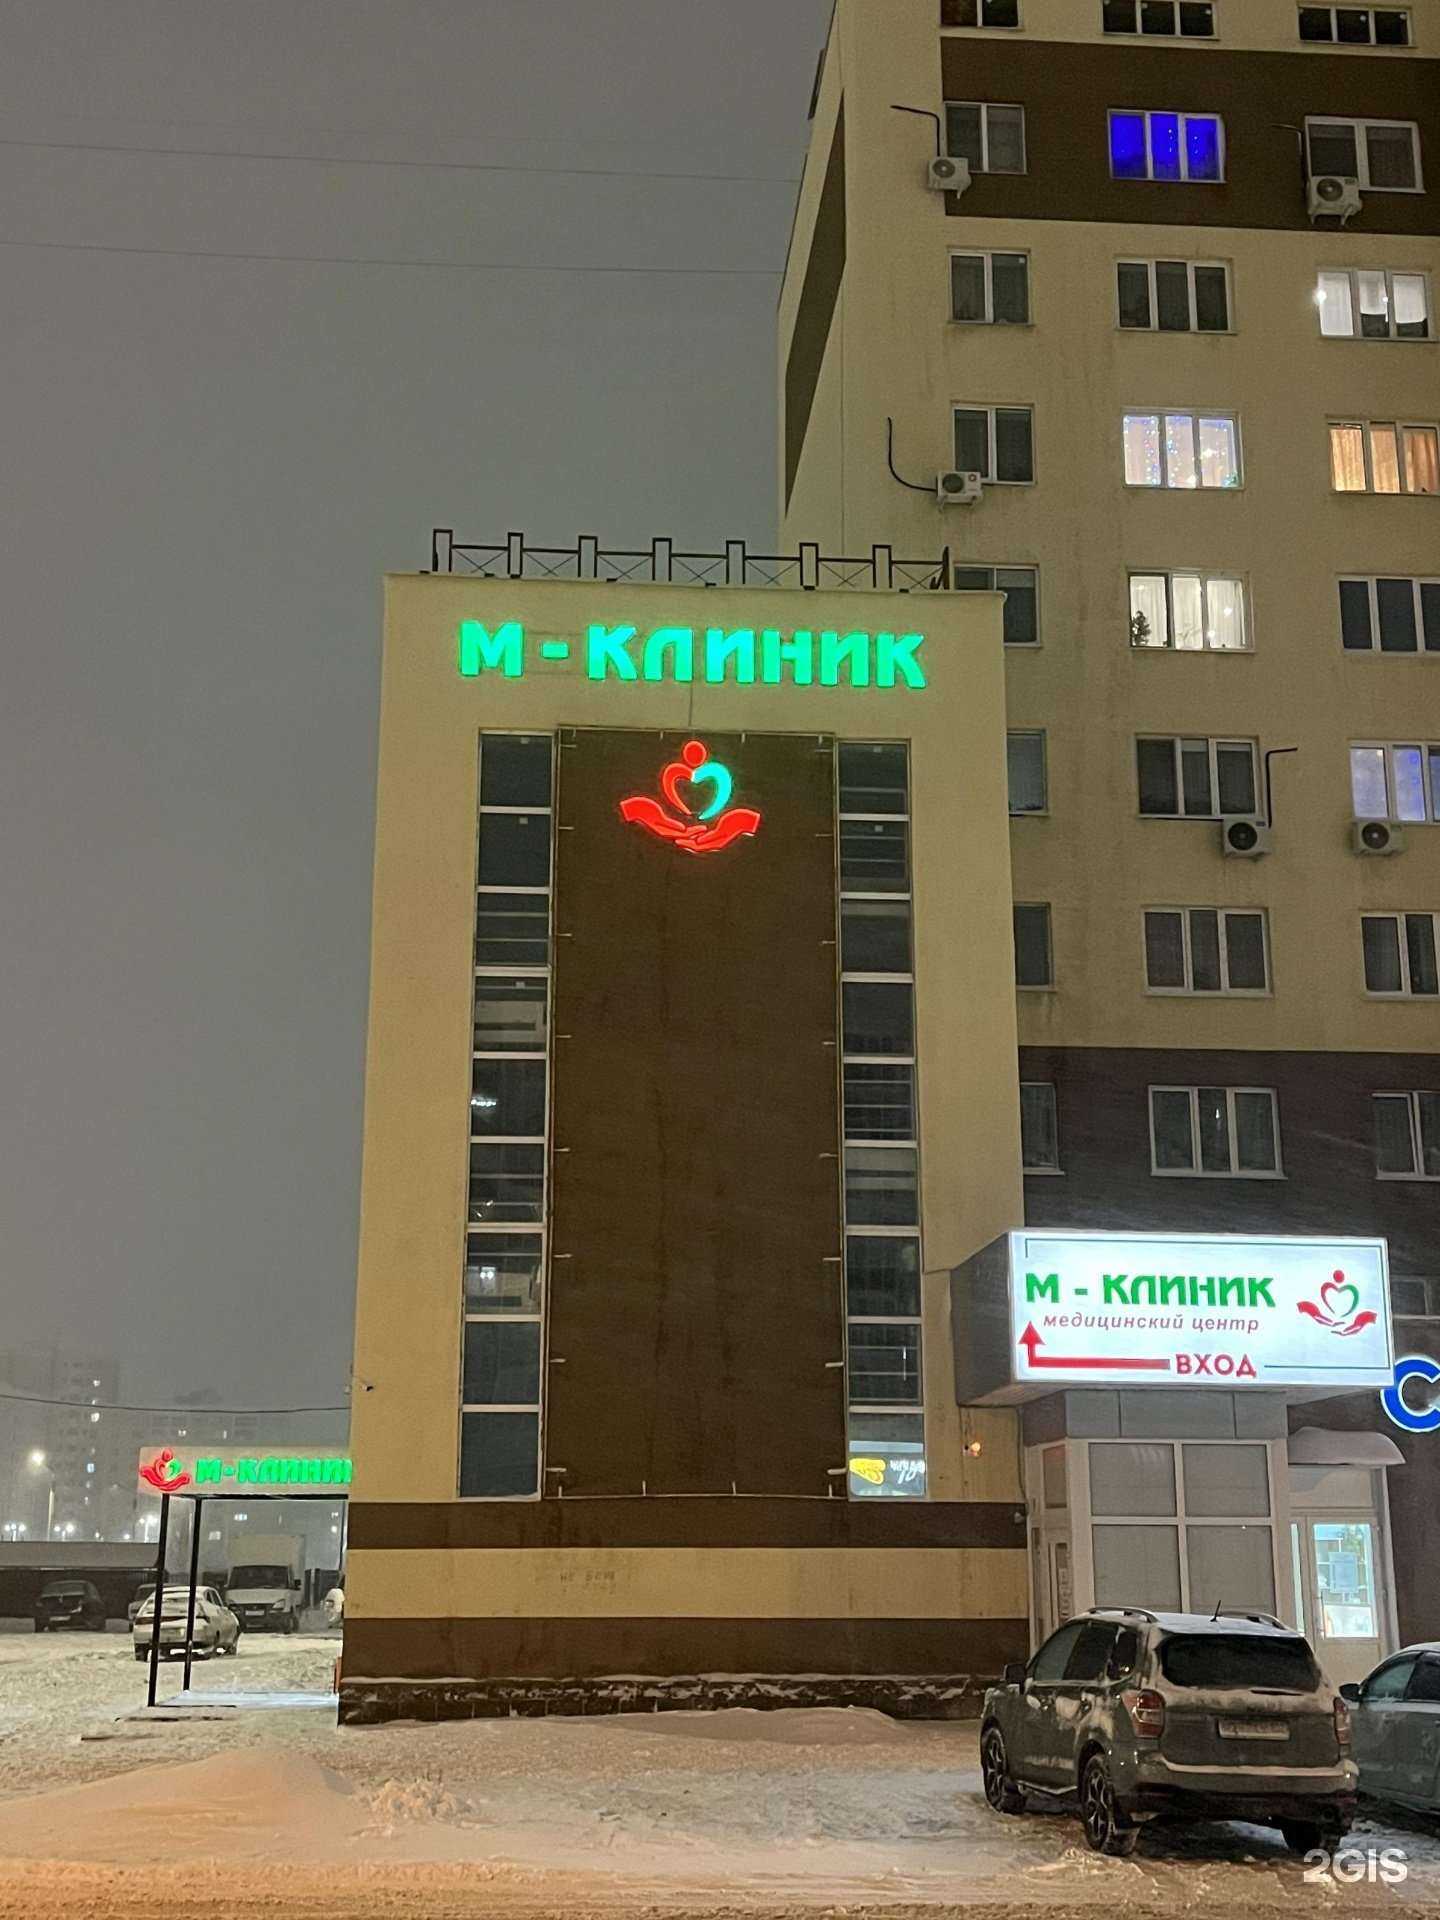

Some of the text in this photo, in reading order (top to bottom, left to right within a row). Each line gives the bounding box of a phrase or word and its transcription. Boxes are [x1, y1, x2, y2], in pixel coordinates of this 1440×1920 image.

[1042, 1311, 1260, 1335] медицинский центр
[1174, 1353, 1258, 1377] ВХОД
